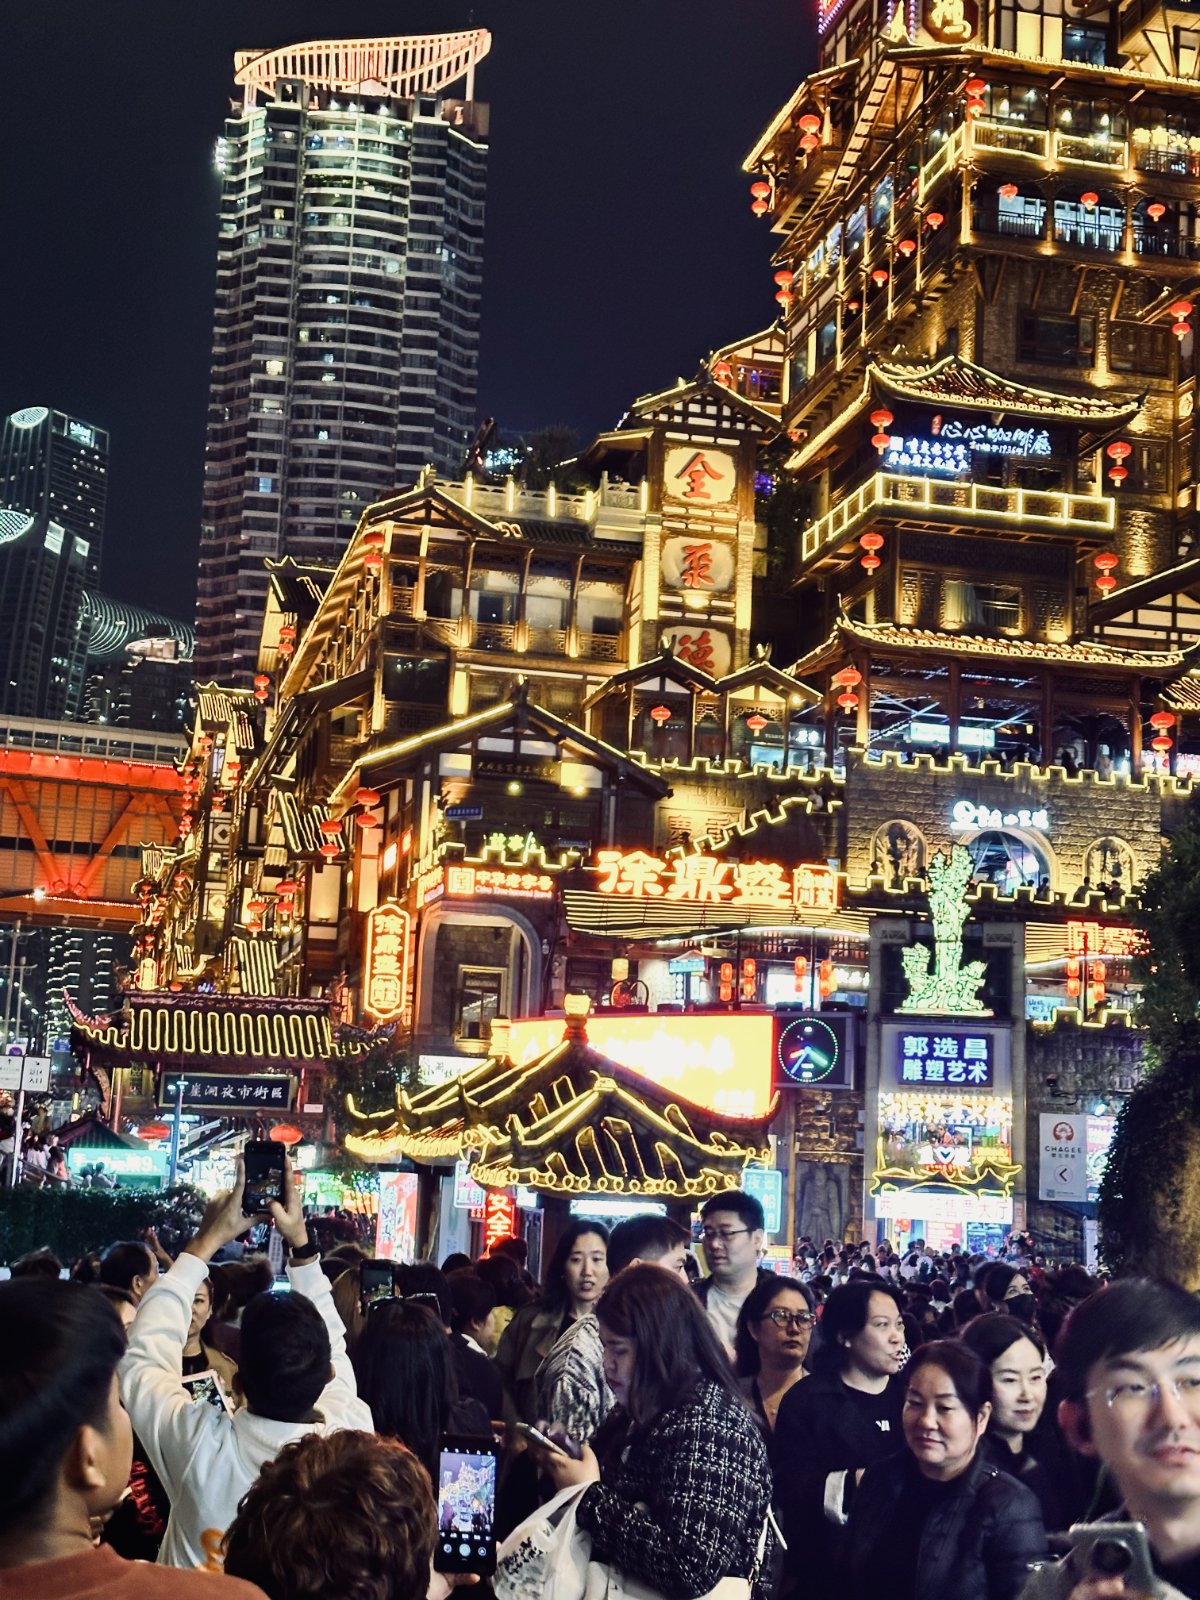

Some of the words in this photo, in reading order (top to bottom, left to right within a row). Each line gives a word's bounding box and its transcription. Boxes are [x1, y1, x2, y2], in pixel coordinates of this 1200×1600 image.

[597, 850, 792, 908] 徐鼎盛
[903, 1036, 988, 1060] 郭选昌
[902, 1059, 988, 1083] 雕塑艺术
[486, 1193, 512, 1258] 安全
